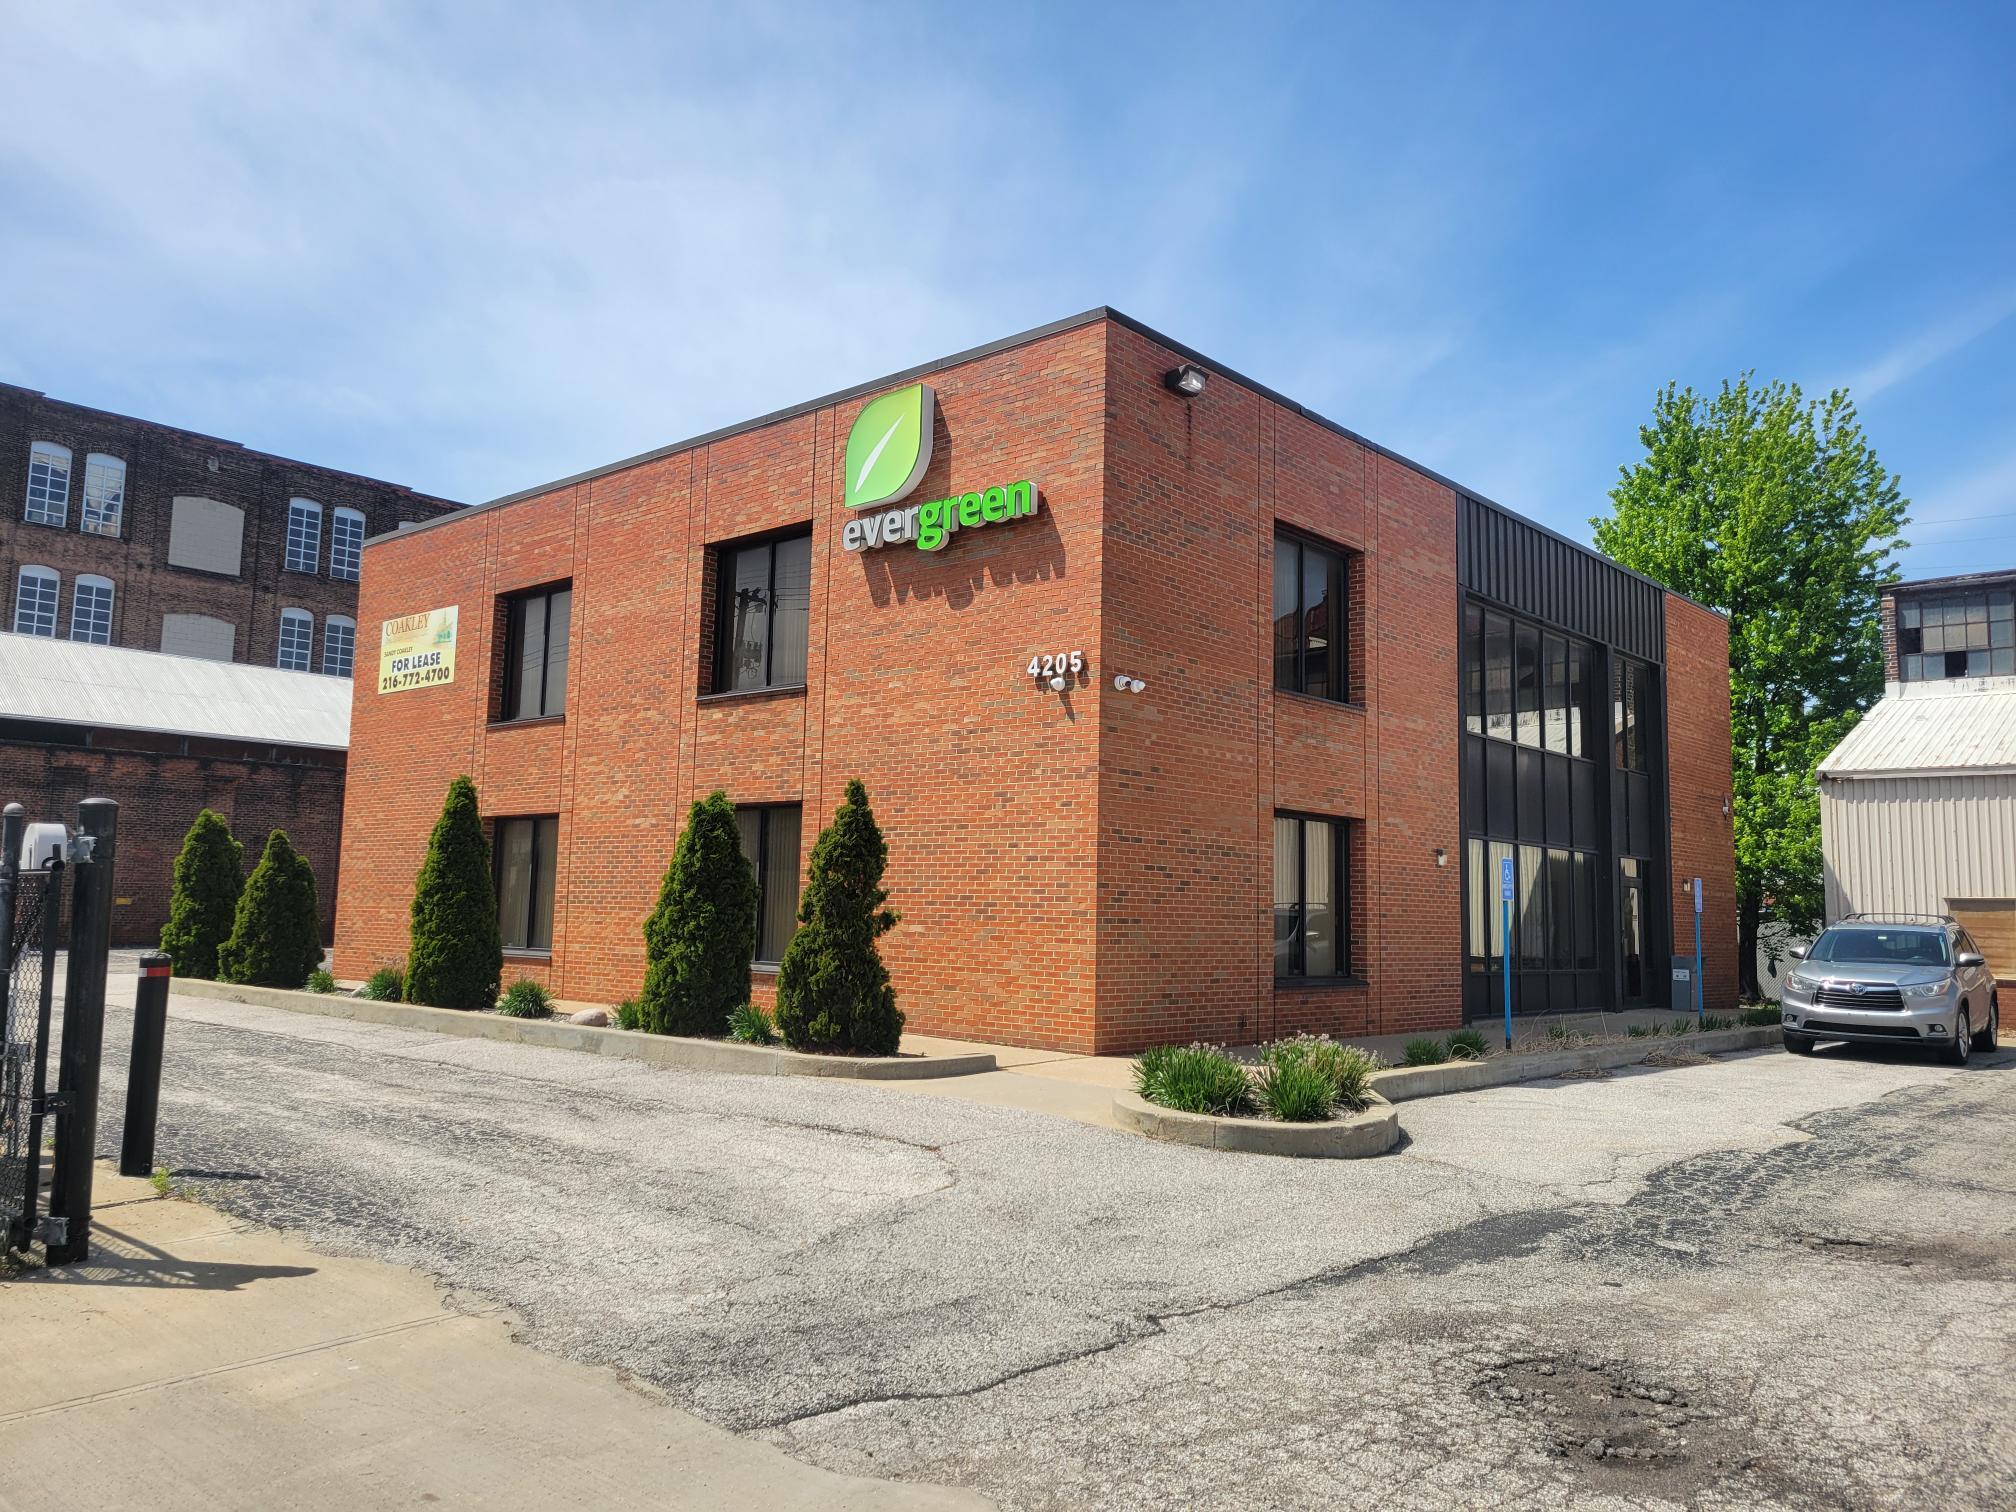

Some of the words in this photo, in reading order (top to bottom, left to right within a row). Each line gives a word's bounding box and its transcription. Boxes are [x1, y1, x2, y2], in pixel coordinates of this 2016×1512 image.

[842, 480, 1033, 551] evergreen
[385, 613, 431, 637] COAKLEY
[391, 657, 410, 674] FOR
[412, 651, 441, 670] LEASE
[1027, 650, 1082, 677] 4205
[382, 666, 450, 690] 216-772-4700
